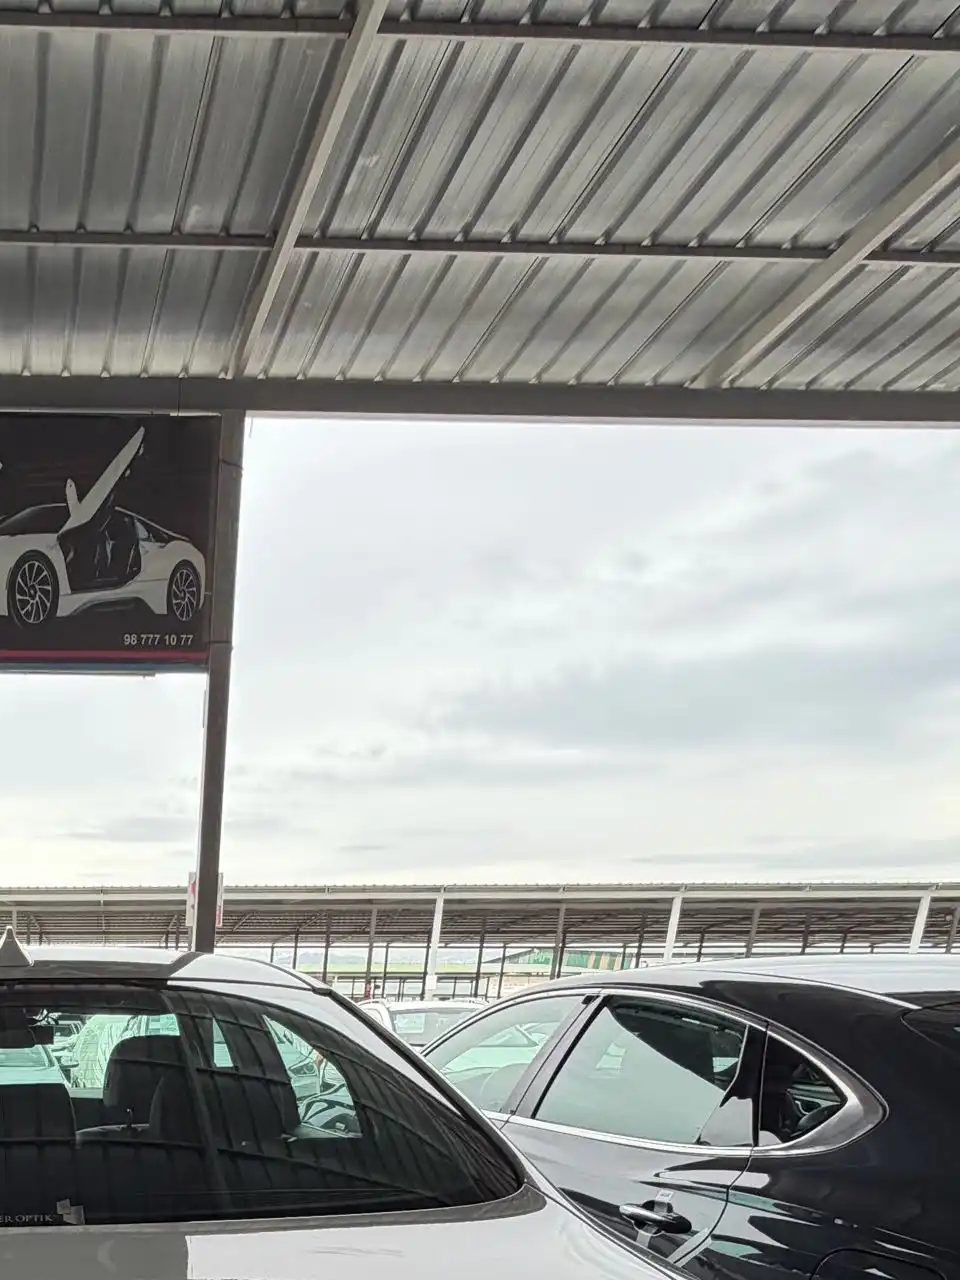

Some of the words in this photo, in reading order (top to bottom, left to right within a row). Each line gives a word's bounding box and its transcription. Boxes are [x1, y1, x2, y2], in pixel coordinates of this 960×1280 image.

[123, 633, 138, 646] 98
[140, 633, 160, 646] 777
[164, 634, 177, 646] 10
[180, 634, 194, 646] 77
[15, 1214, 54, 1223] OPTIK
